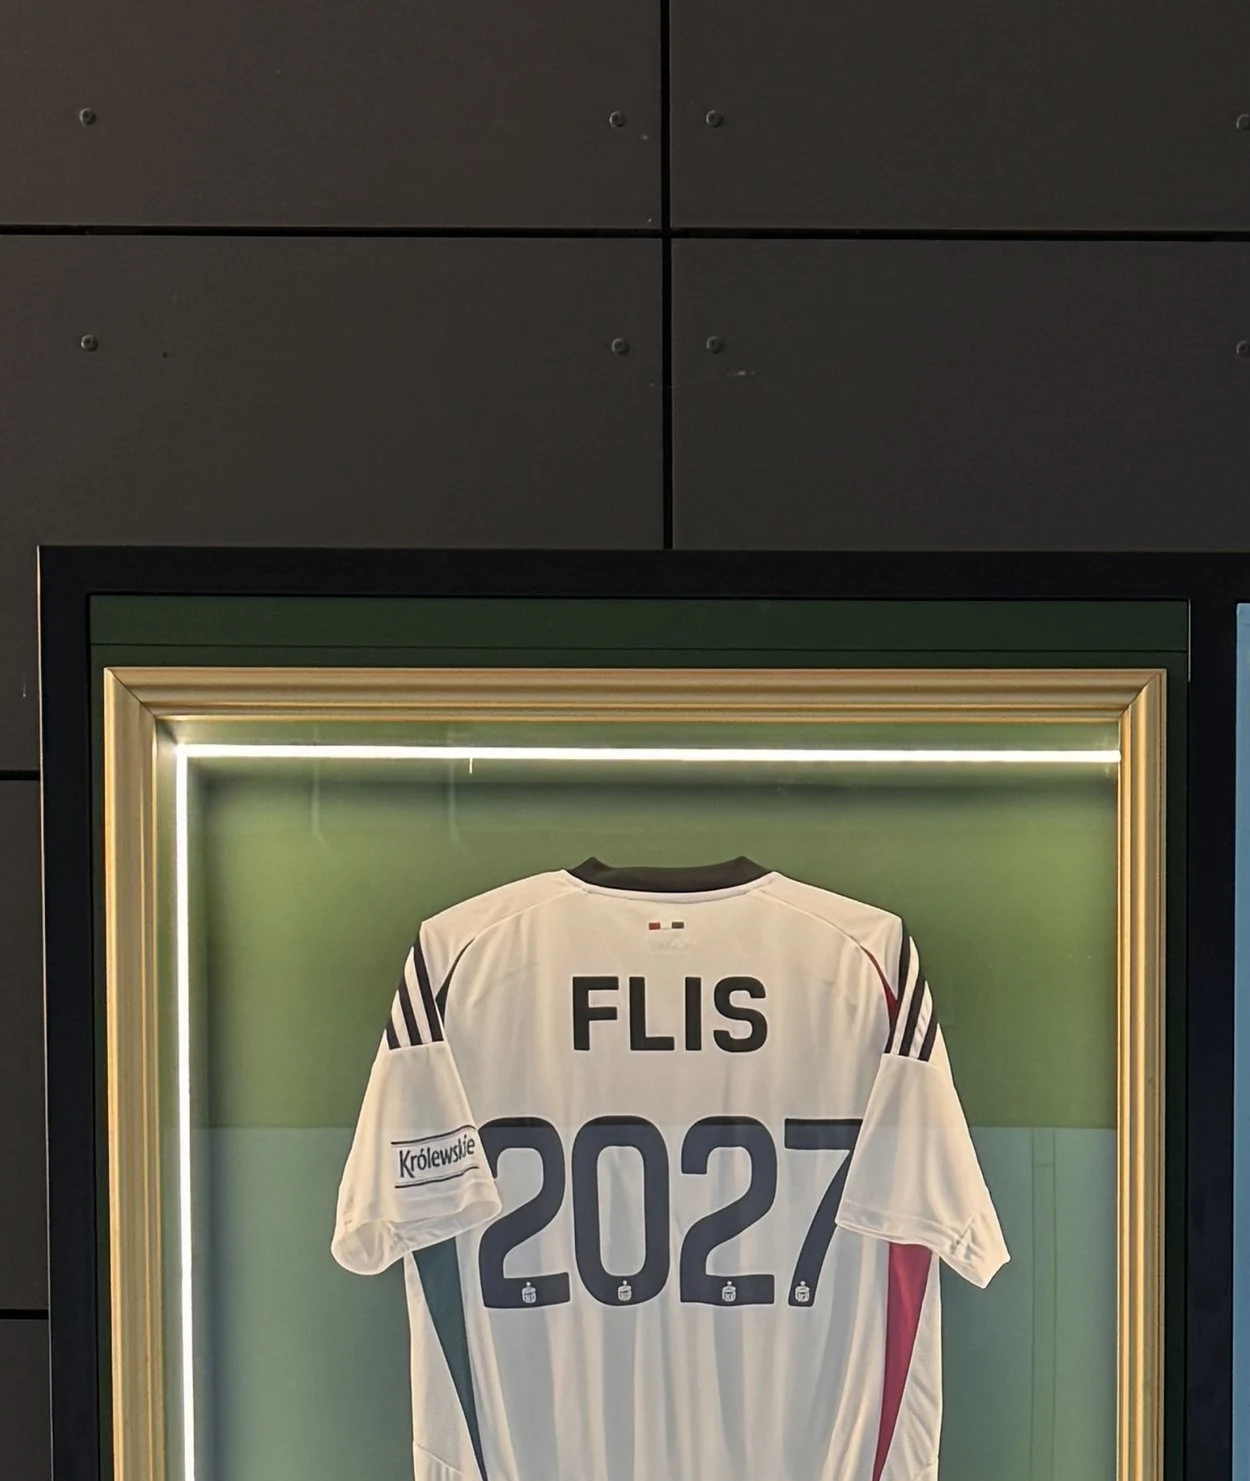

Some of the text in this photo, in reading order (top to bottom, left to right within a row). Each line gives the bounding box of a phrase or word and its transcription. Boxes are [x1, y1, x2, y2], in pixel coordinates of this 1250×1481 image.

[572, 976, 768, 1053] FLIS
[399, 1134, 476, 1179] Królewskie
[478, 1115, 863, 1307] 2027
